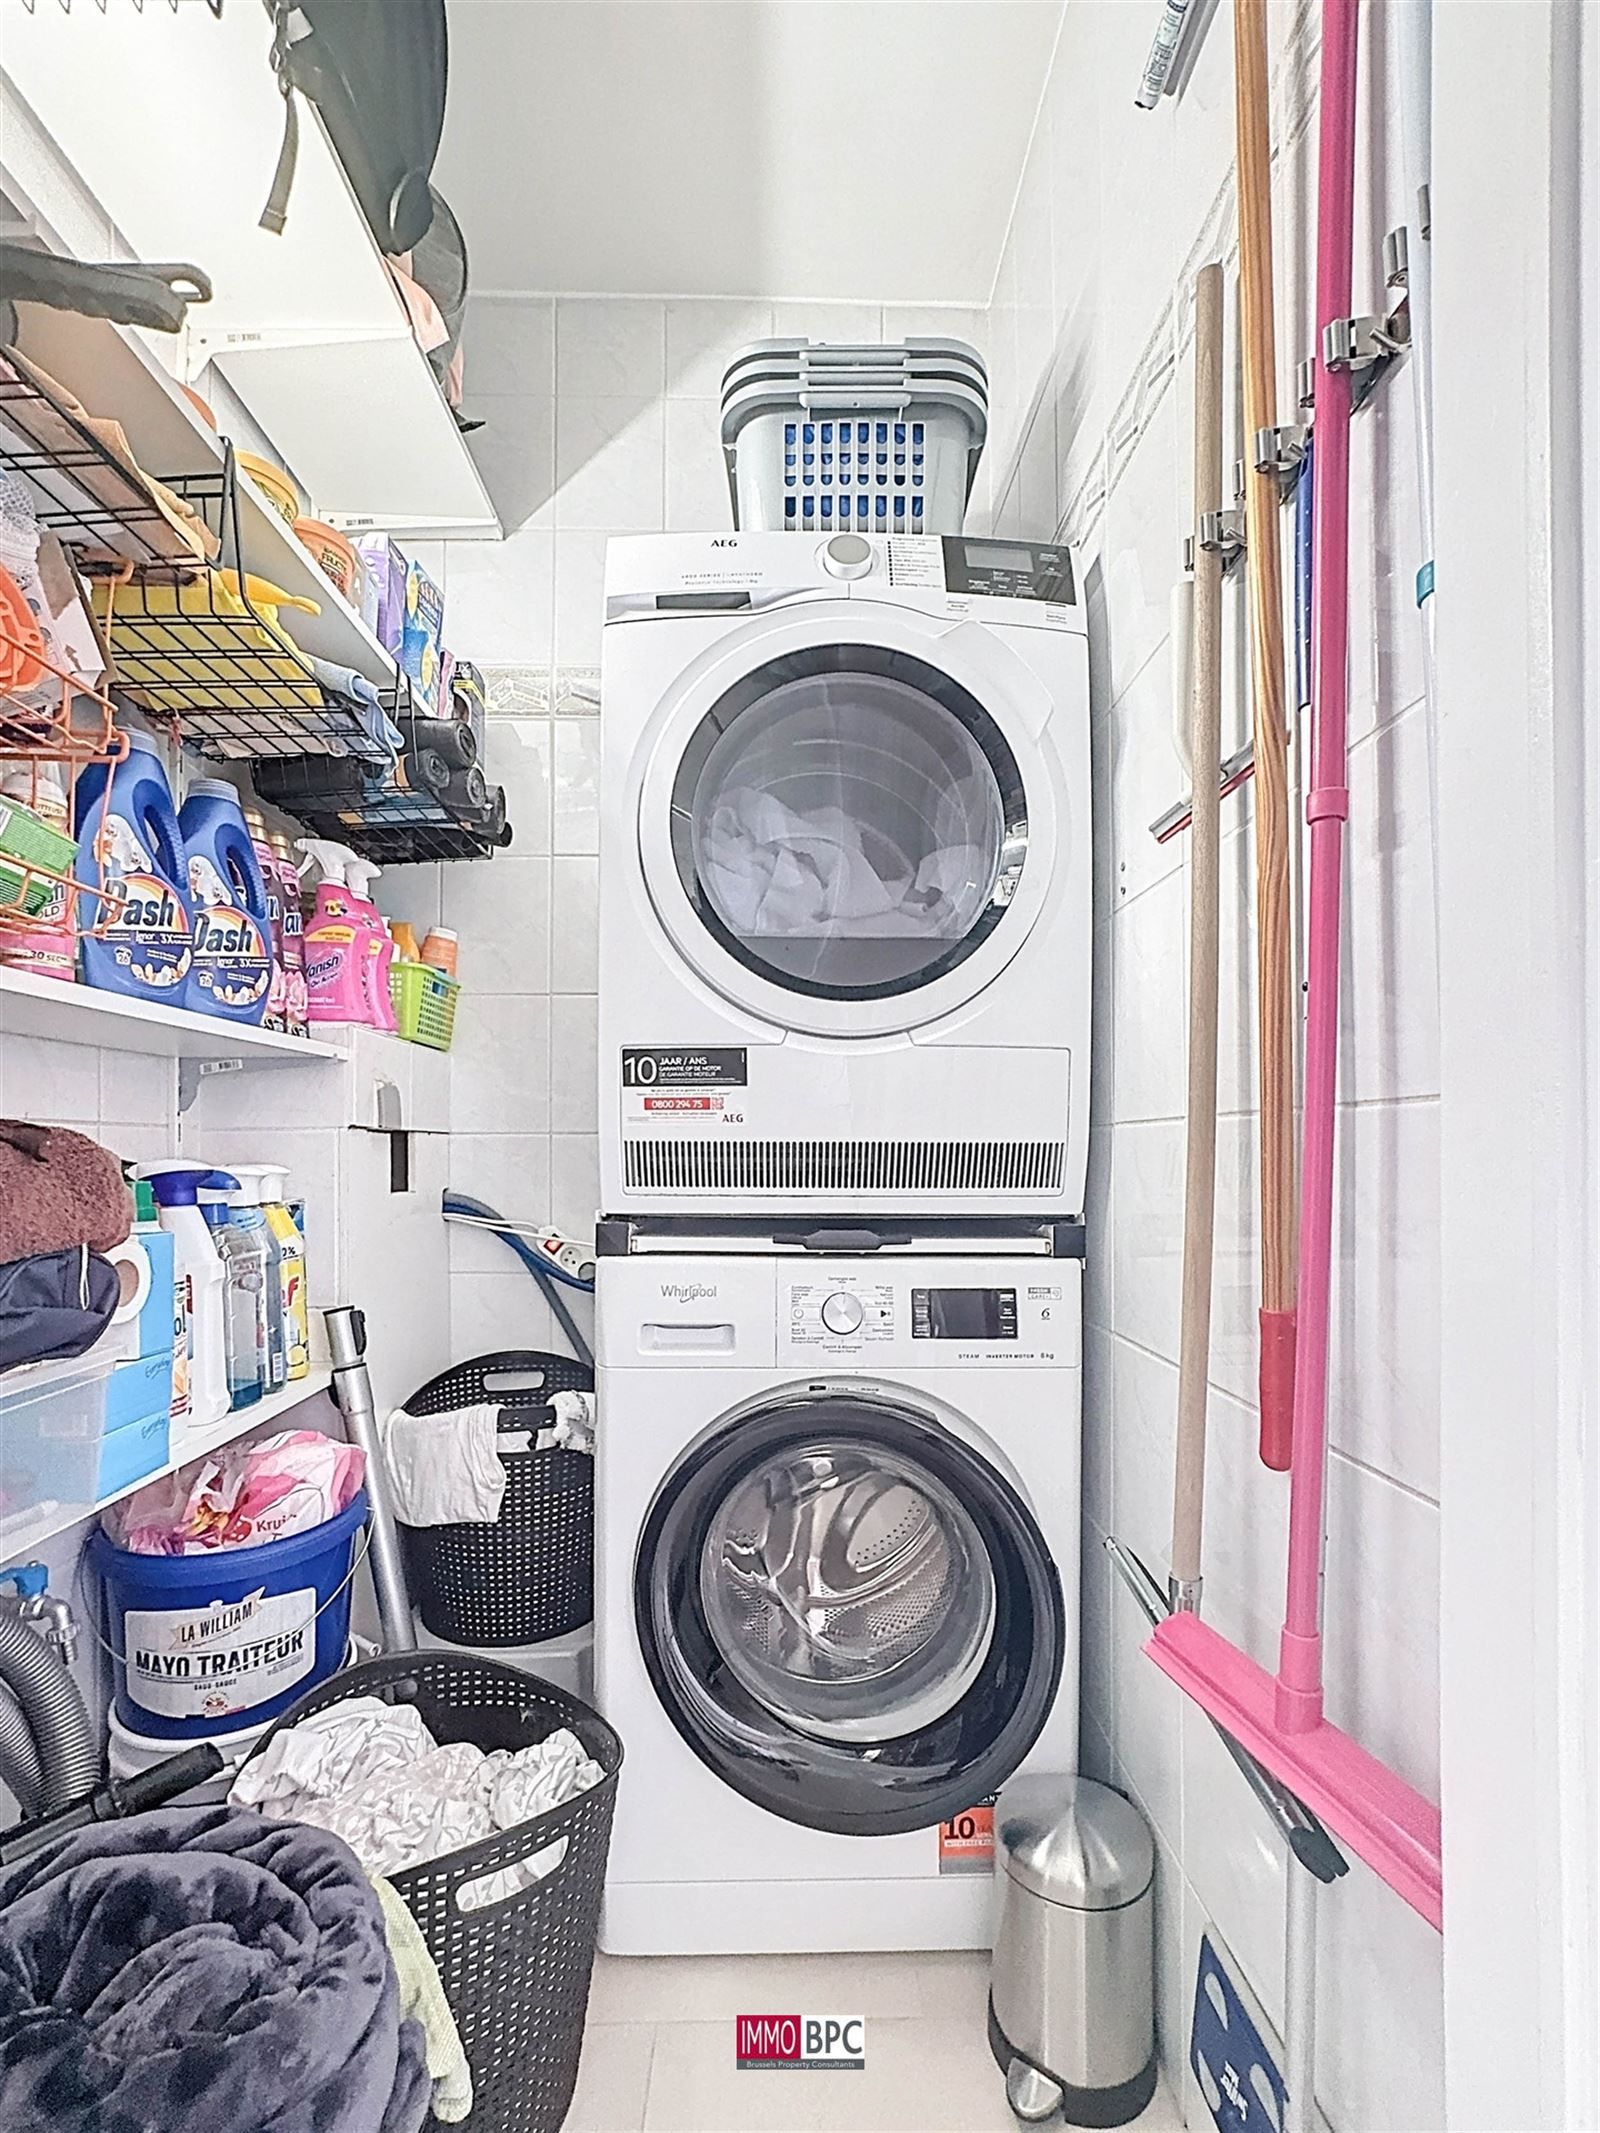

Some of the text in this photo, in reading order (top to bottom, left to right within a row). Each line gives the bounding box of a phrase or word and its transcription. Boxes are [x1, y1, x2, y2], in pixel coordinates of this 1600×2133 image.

[711, 539, 738, 548] AEG
[97, 879, 174, 926] Dash
[194, 912, 253, 953] Dash
[624, 1056, 657, 1084] 10
[659, 1057, 682, 1065] JAAR
[689, 1057, 707, 1065] ANS
[651, 1100, 674, 1108] 0800
[692, 1100, 703, 1108] 75
[722, 1113, 744, 1123] AEG
[660, 1284, 717, 1302] Whirlpool
[181, 1626, 195, 1642] LA
[199, 1602, 253, 1637] WILLIAM
[136, 1650, 190, 1677] MAYO
[197, 1629, 304, 1676] TRAITEUR
[945, 1816, 976, 1839] 10
